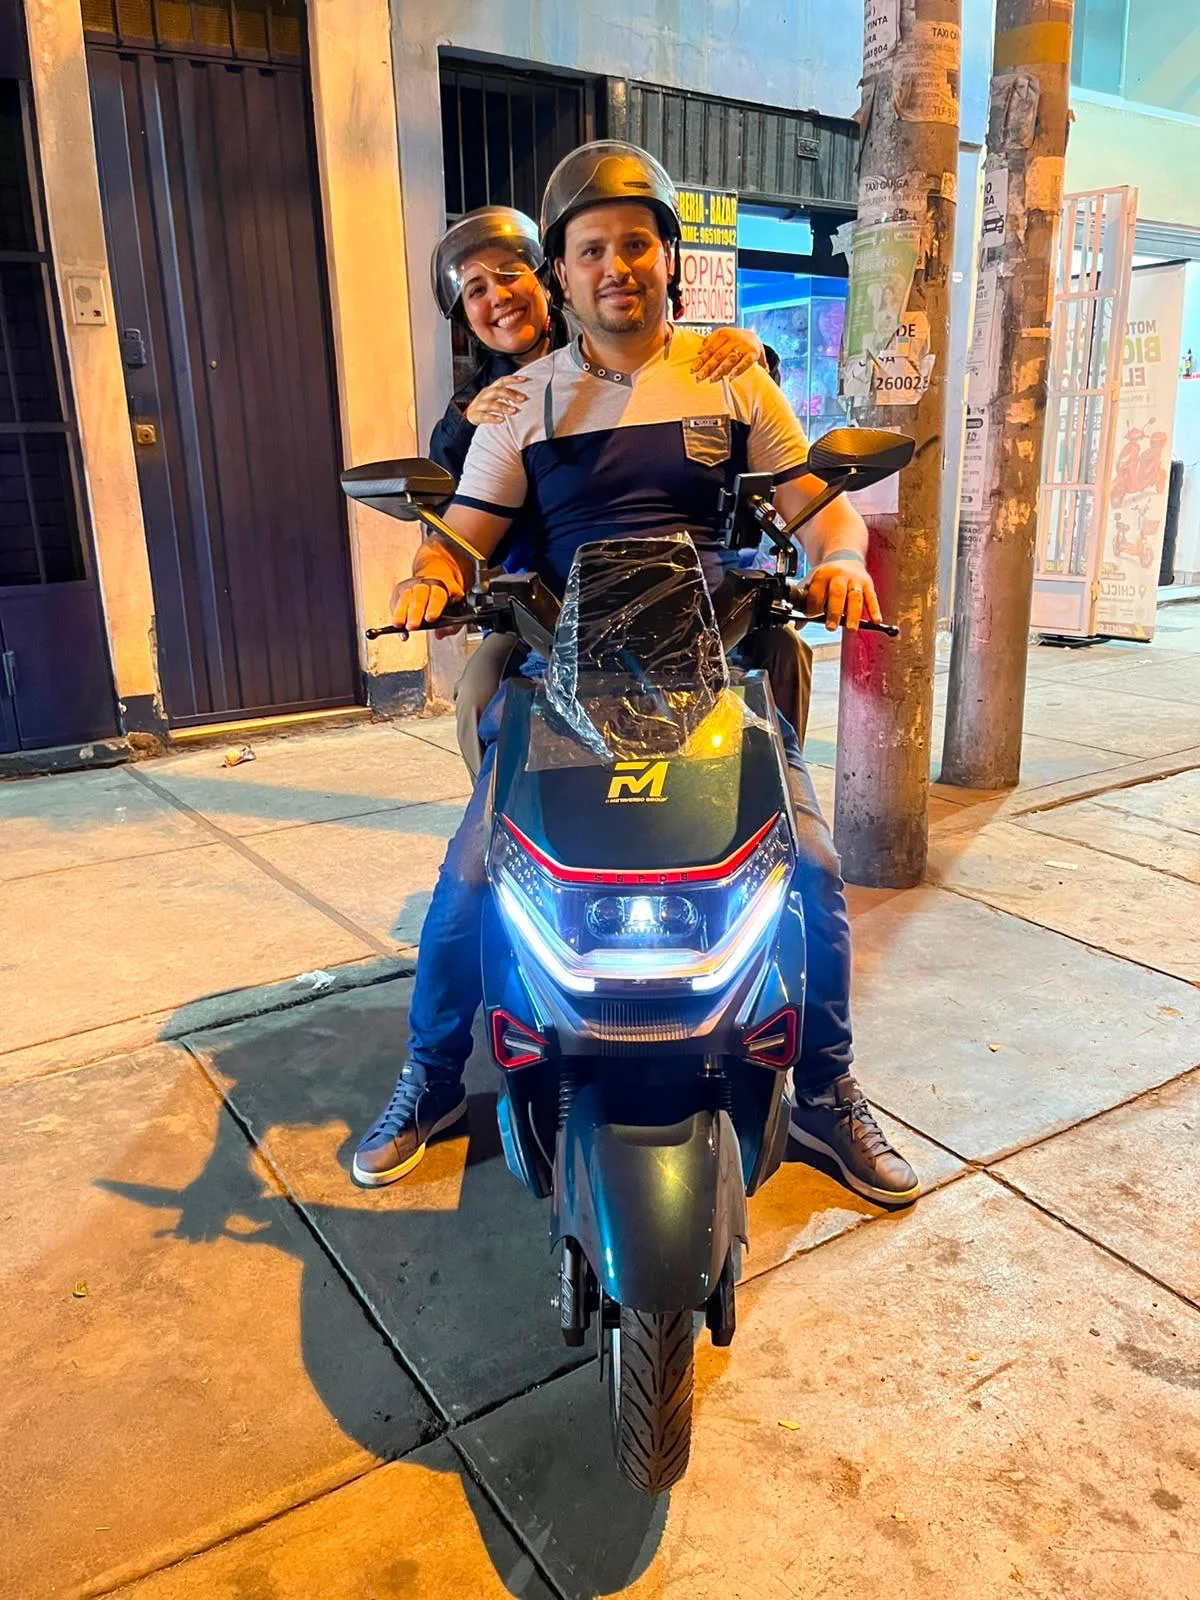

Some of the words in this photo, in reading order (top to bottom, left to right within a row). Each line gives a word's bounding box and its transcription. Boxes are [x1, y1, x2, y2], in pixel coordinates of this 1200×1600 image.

[710, 194, 737, 226] BAZAR
[684, 255, 734, 286] OPIAS
[682, 288, 734, 320] PRESIONES
